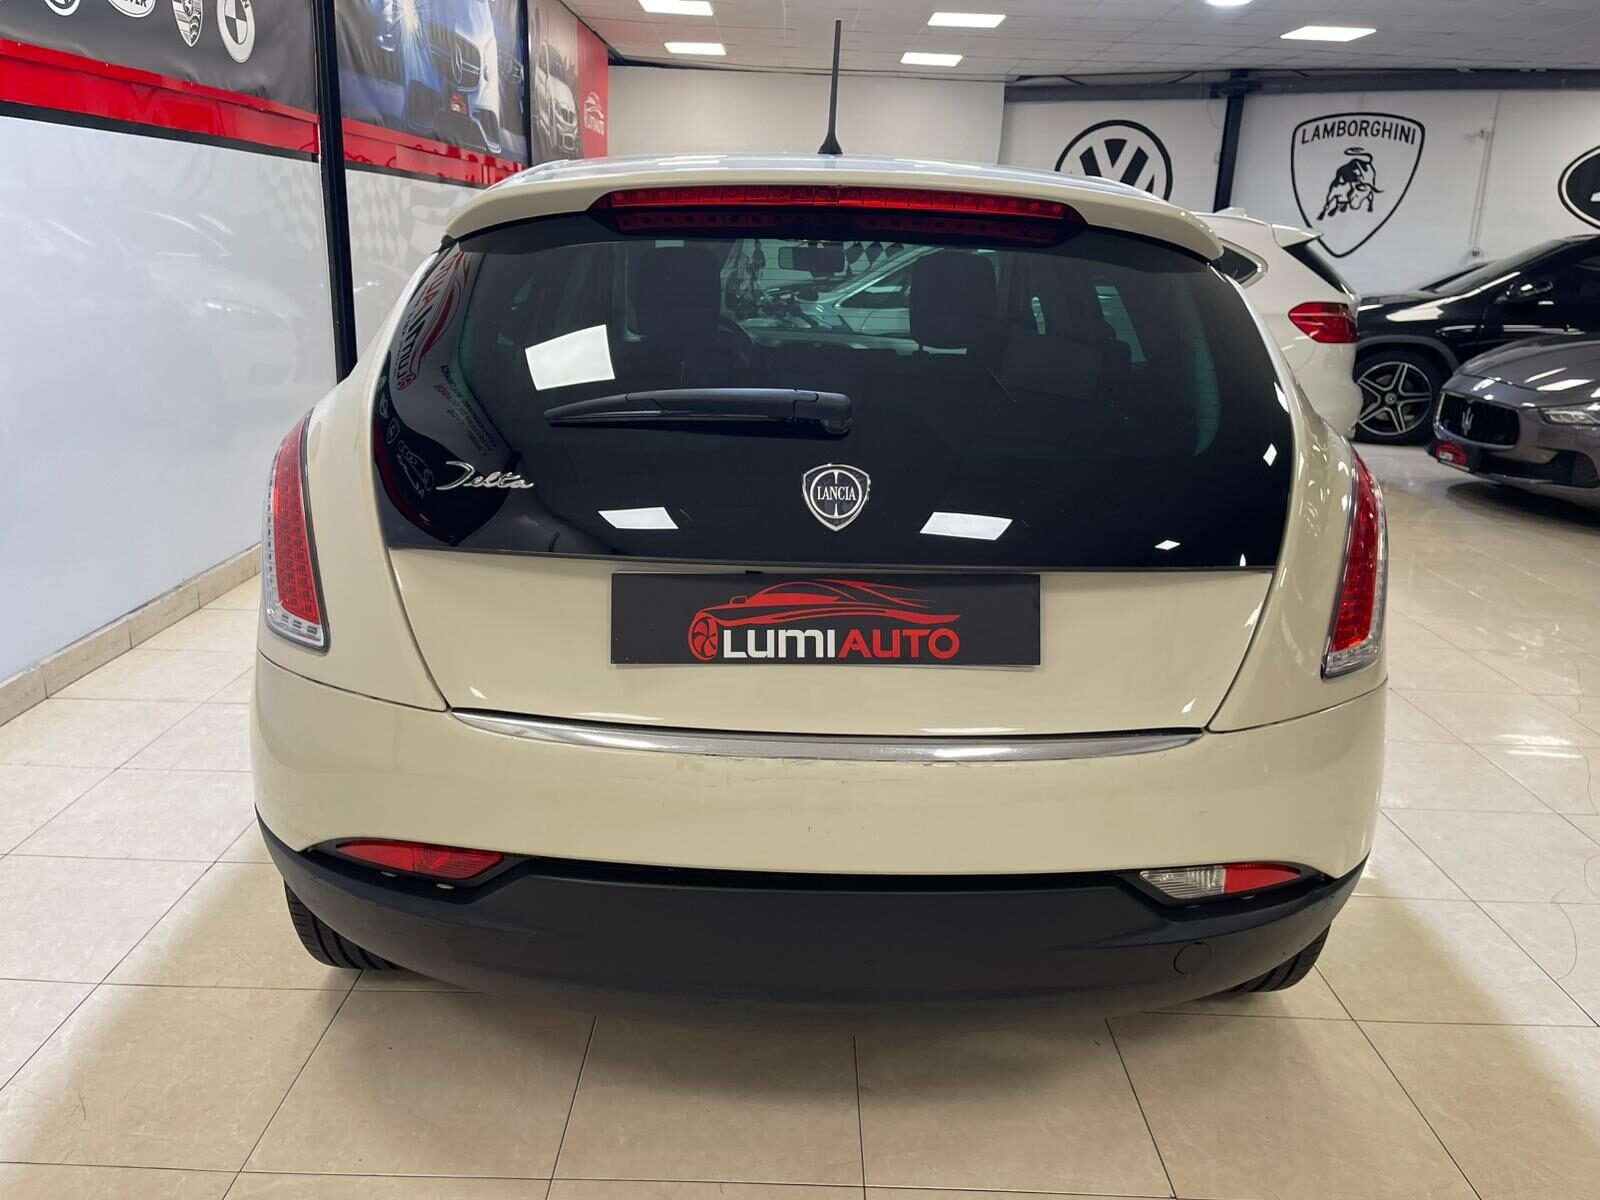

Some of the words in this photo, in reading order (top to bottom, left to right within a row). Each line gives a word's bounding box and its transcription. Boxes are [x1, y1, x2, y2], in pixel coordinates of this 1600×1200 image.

[1301, 119, 1417, 145] LAMBORGHINI
[436, 461, 534, 490] Delta
[817, 486, 857, 501] LANCIA
[723, 627, 961, 660] LUMIAUTO
